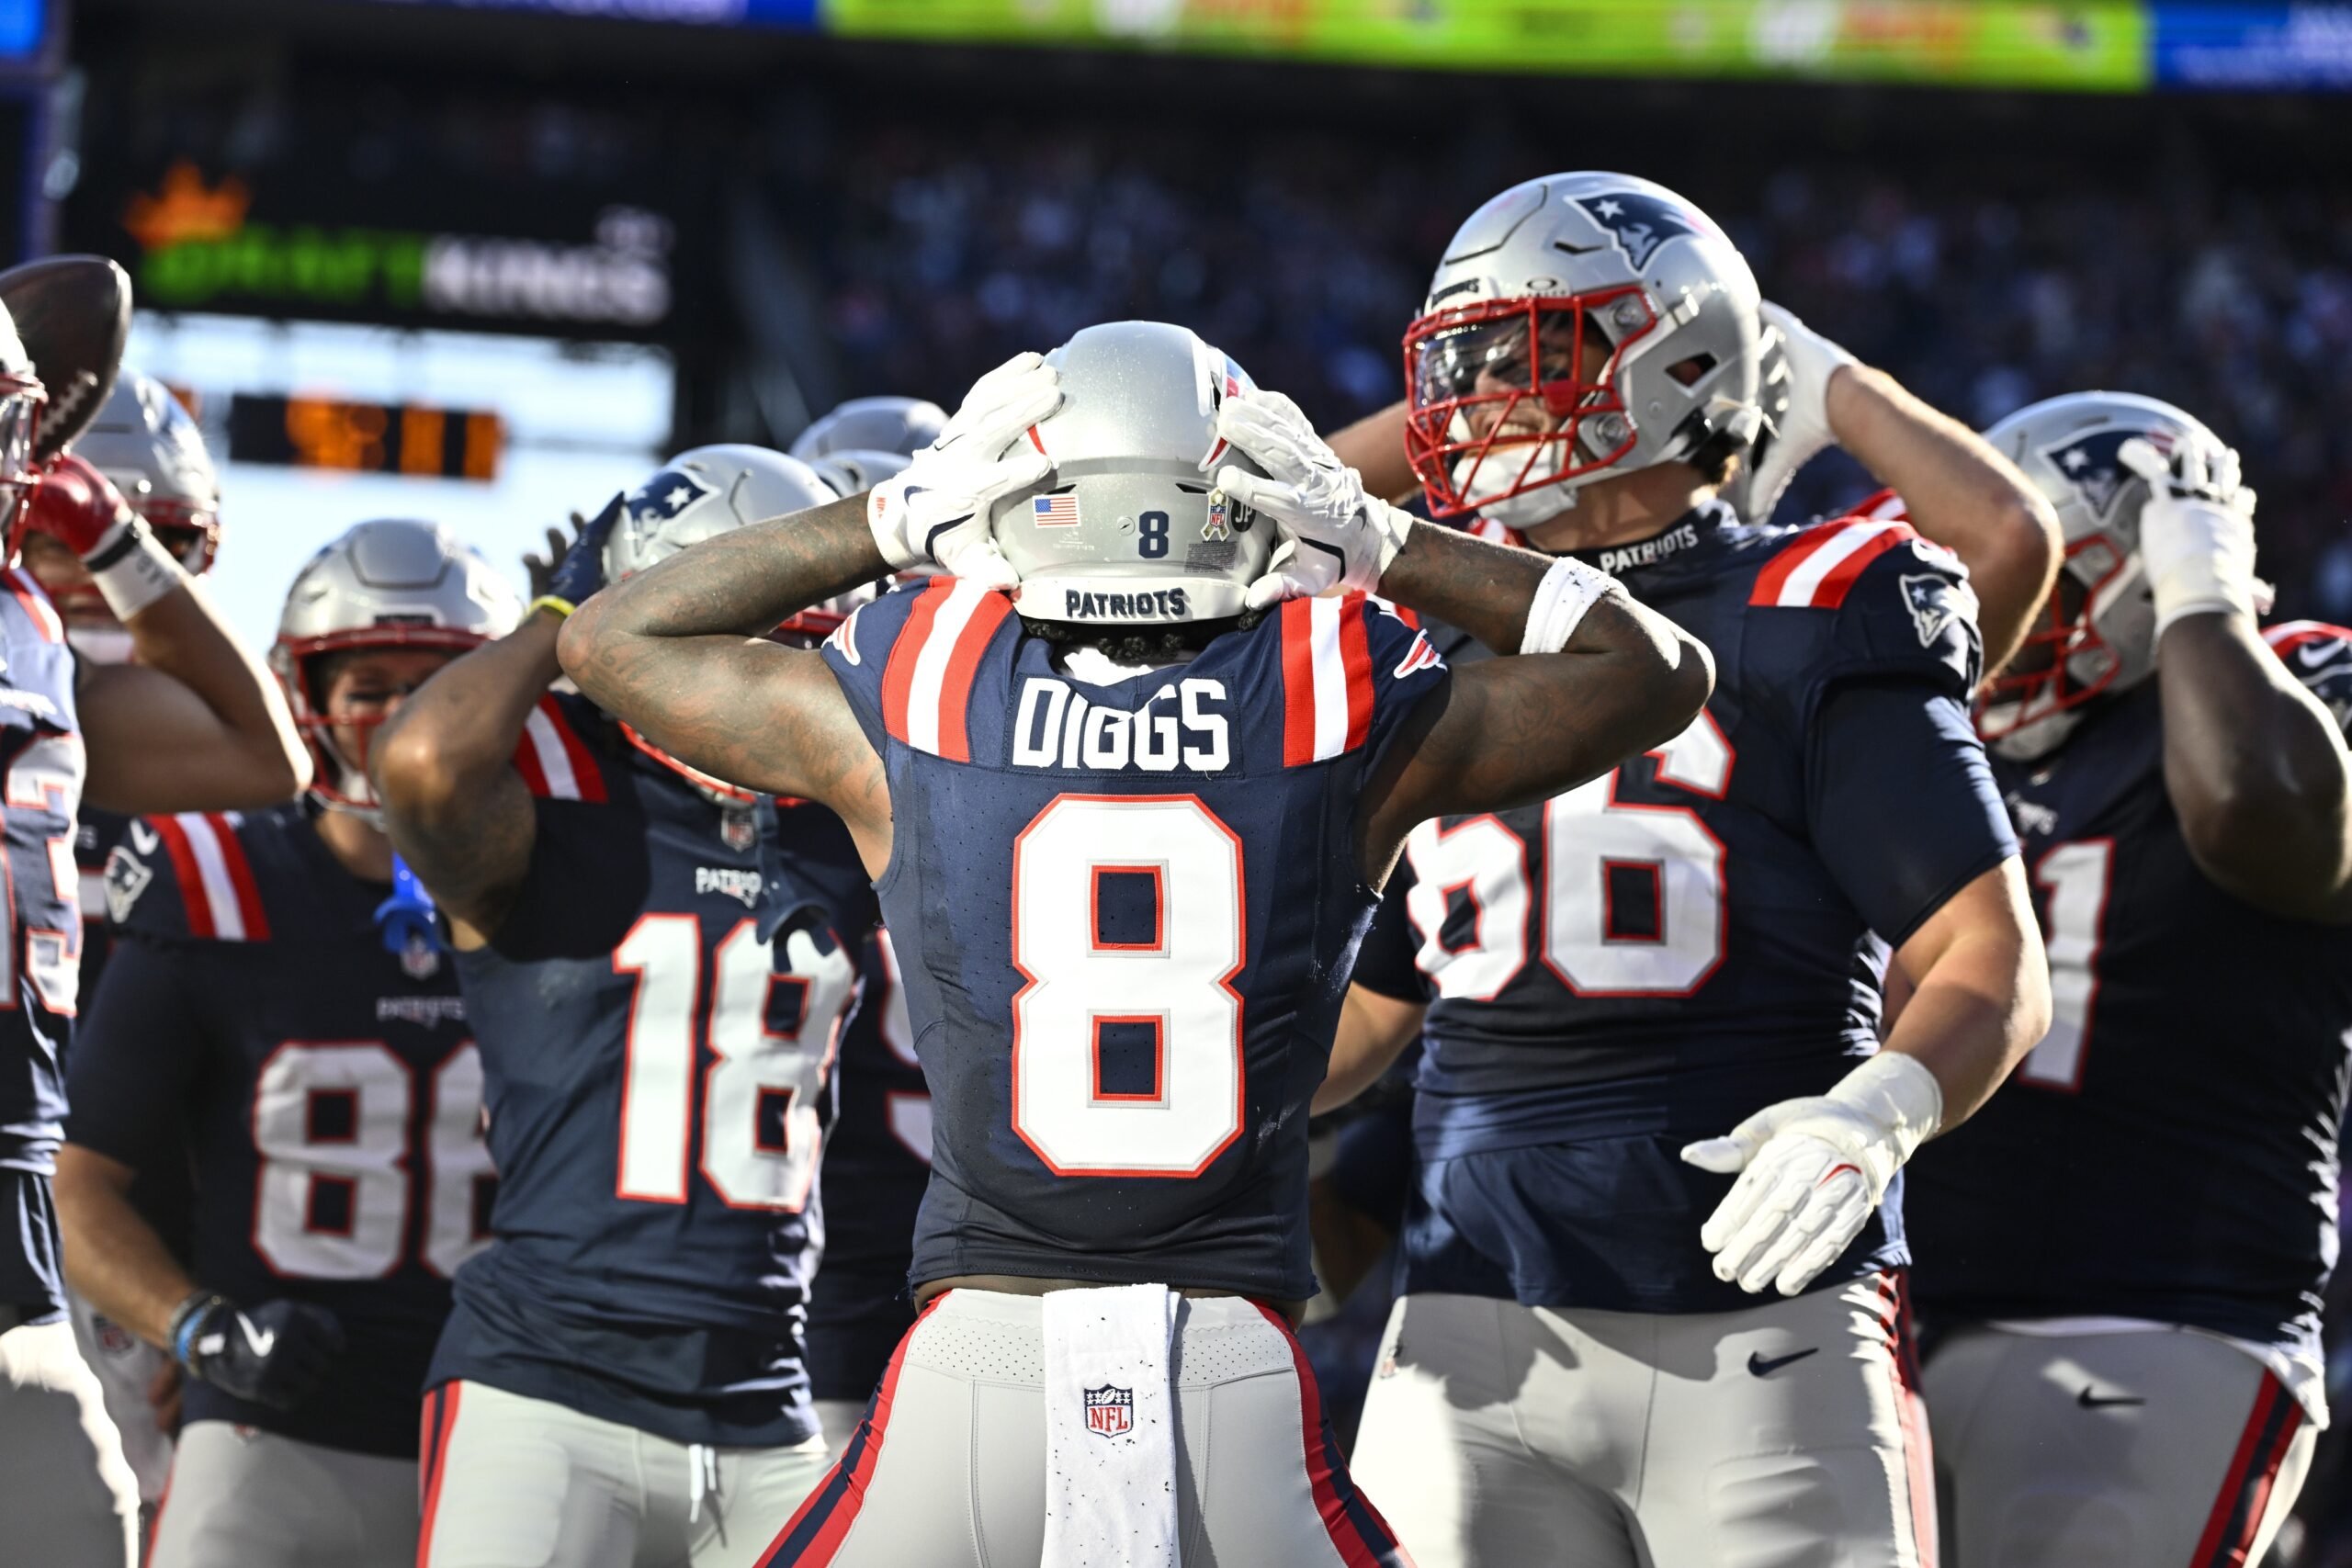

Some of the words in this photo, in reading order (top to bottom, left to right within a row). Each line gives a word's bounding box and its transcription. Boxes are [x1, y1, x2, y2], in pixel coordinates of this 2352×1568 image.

[1138, 511, 1169, 558] 8
[1235, 502, 1253, 524] JP
[1599, 524, 1699, 577] PATRIOTS
[1066, 587, 1185, 618] PATRIOTS
[1012, 677, 1230, 772] DIGGS
[1012, 793, 1246, 1179] 8
[611, 911, 856, 1213] 18
[1089, 1406, 1128, 1433] NFL
